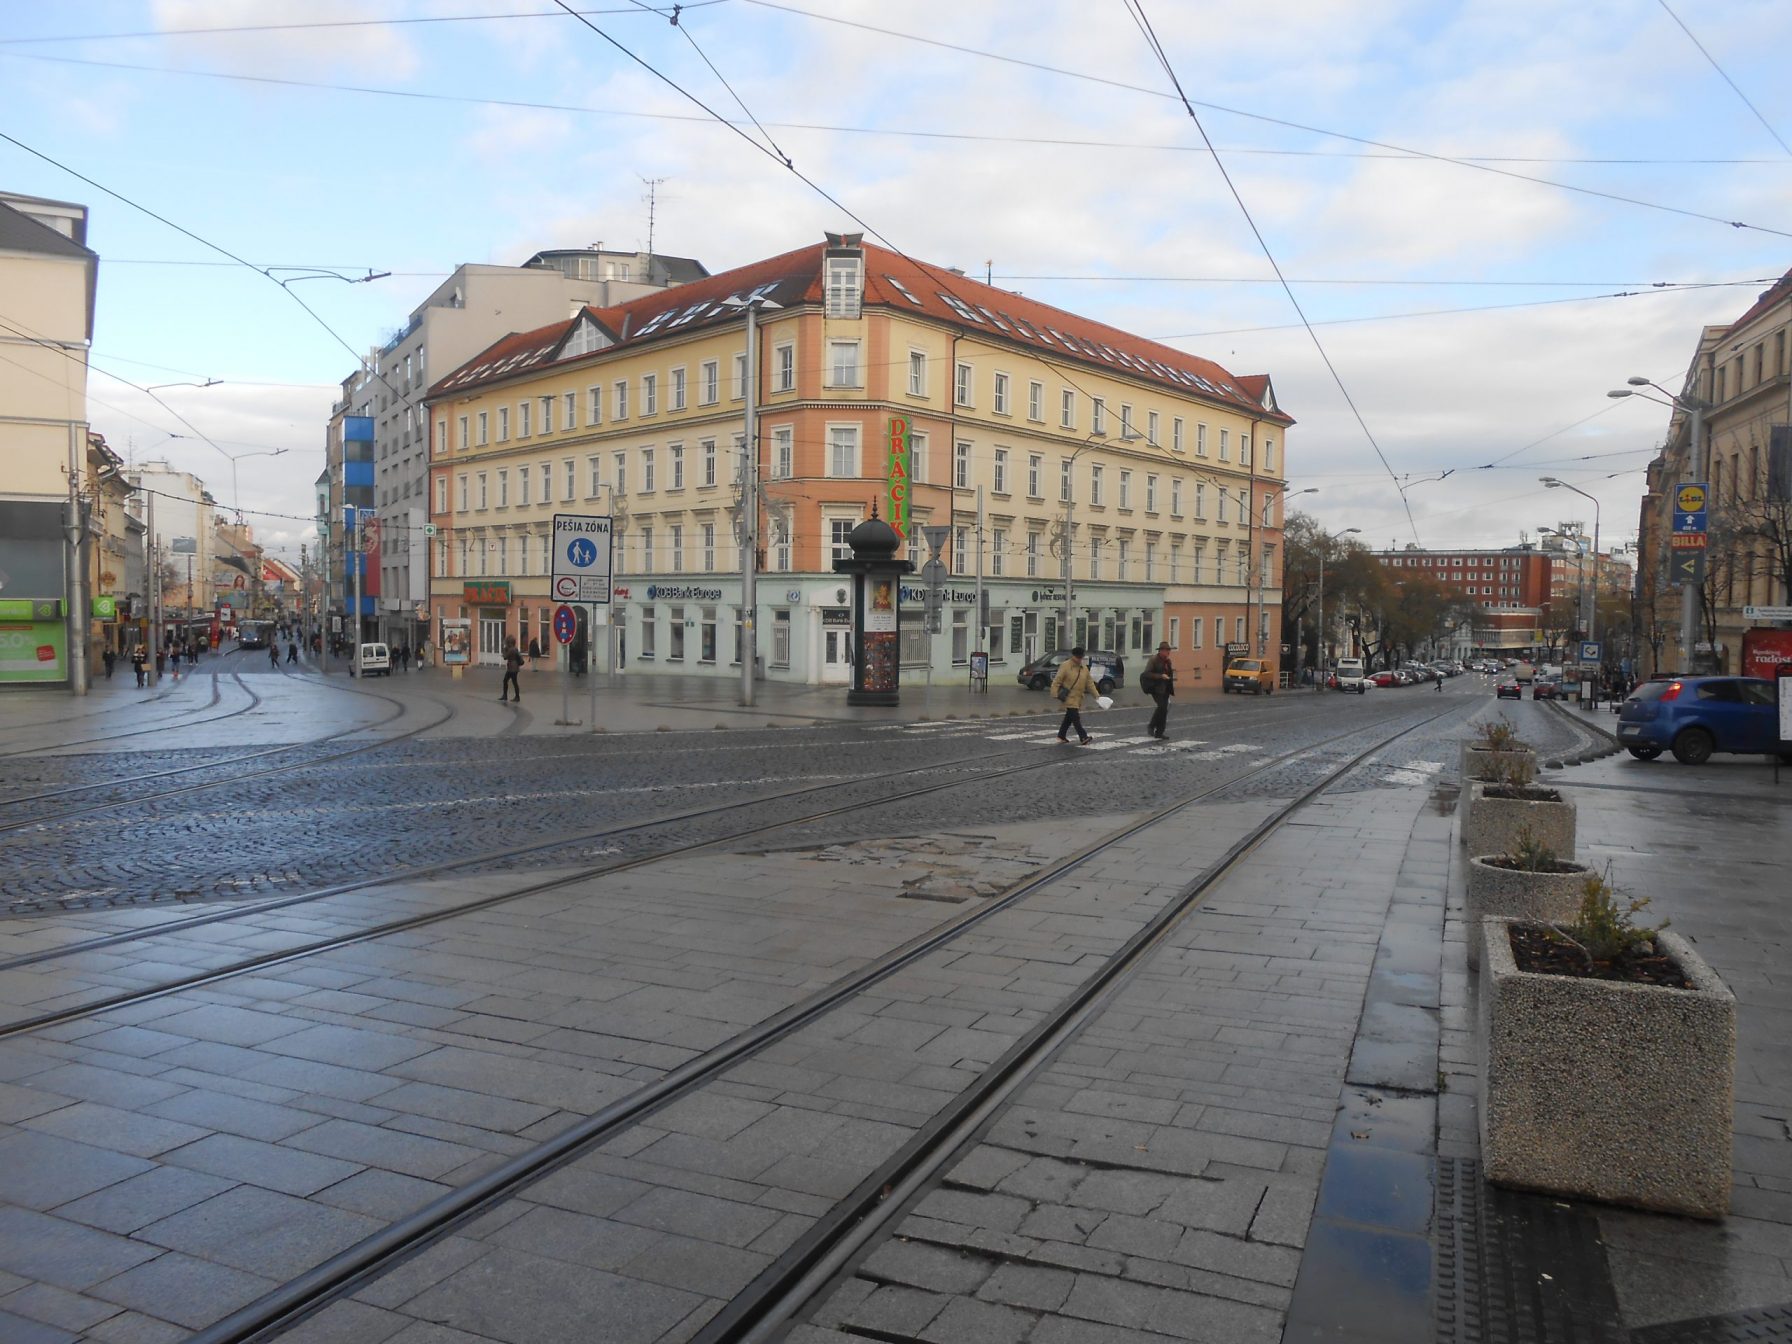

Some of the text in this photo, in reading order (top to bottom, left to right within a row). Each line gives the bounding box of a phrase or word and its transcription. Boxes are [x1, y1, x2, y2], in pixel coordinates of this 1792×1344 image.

[890, 417, 906, 538] DRÁČIK
[556, 519, 609, 534] PEŠIA ZÓNA
[1672, 537, 1705, 547] BILLA
[673, 586, 693, 599] Bank
[694, 586, 722, 600] Europe
[910, 588, 926, 601] KD
[952, 589, 977, 604] Europ
